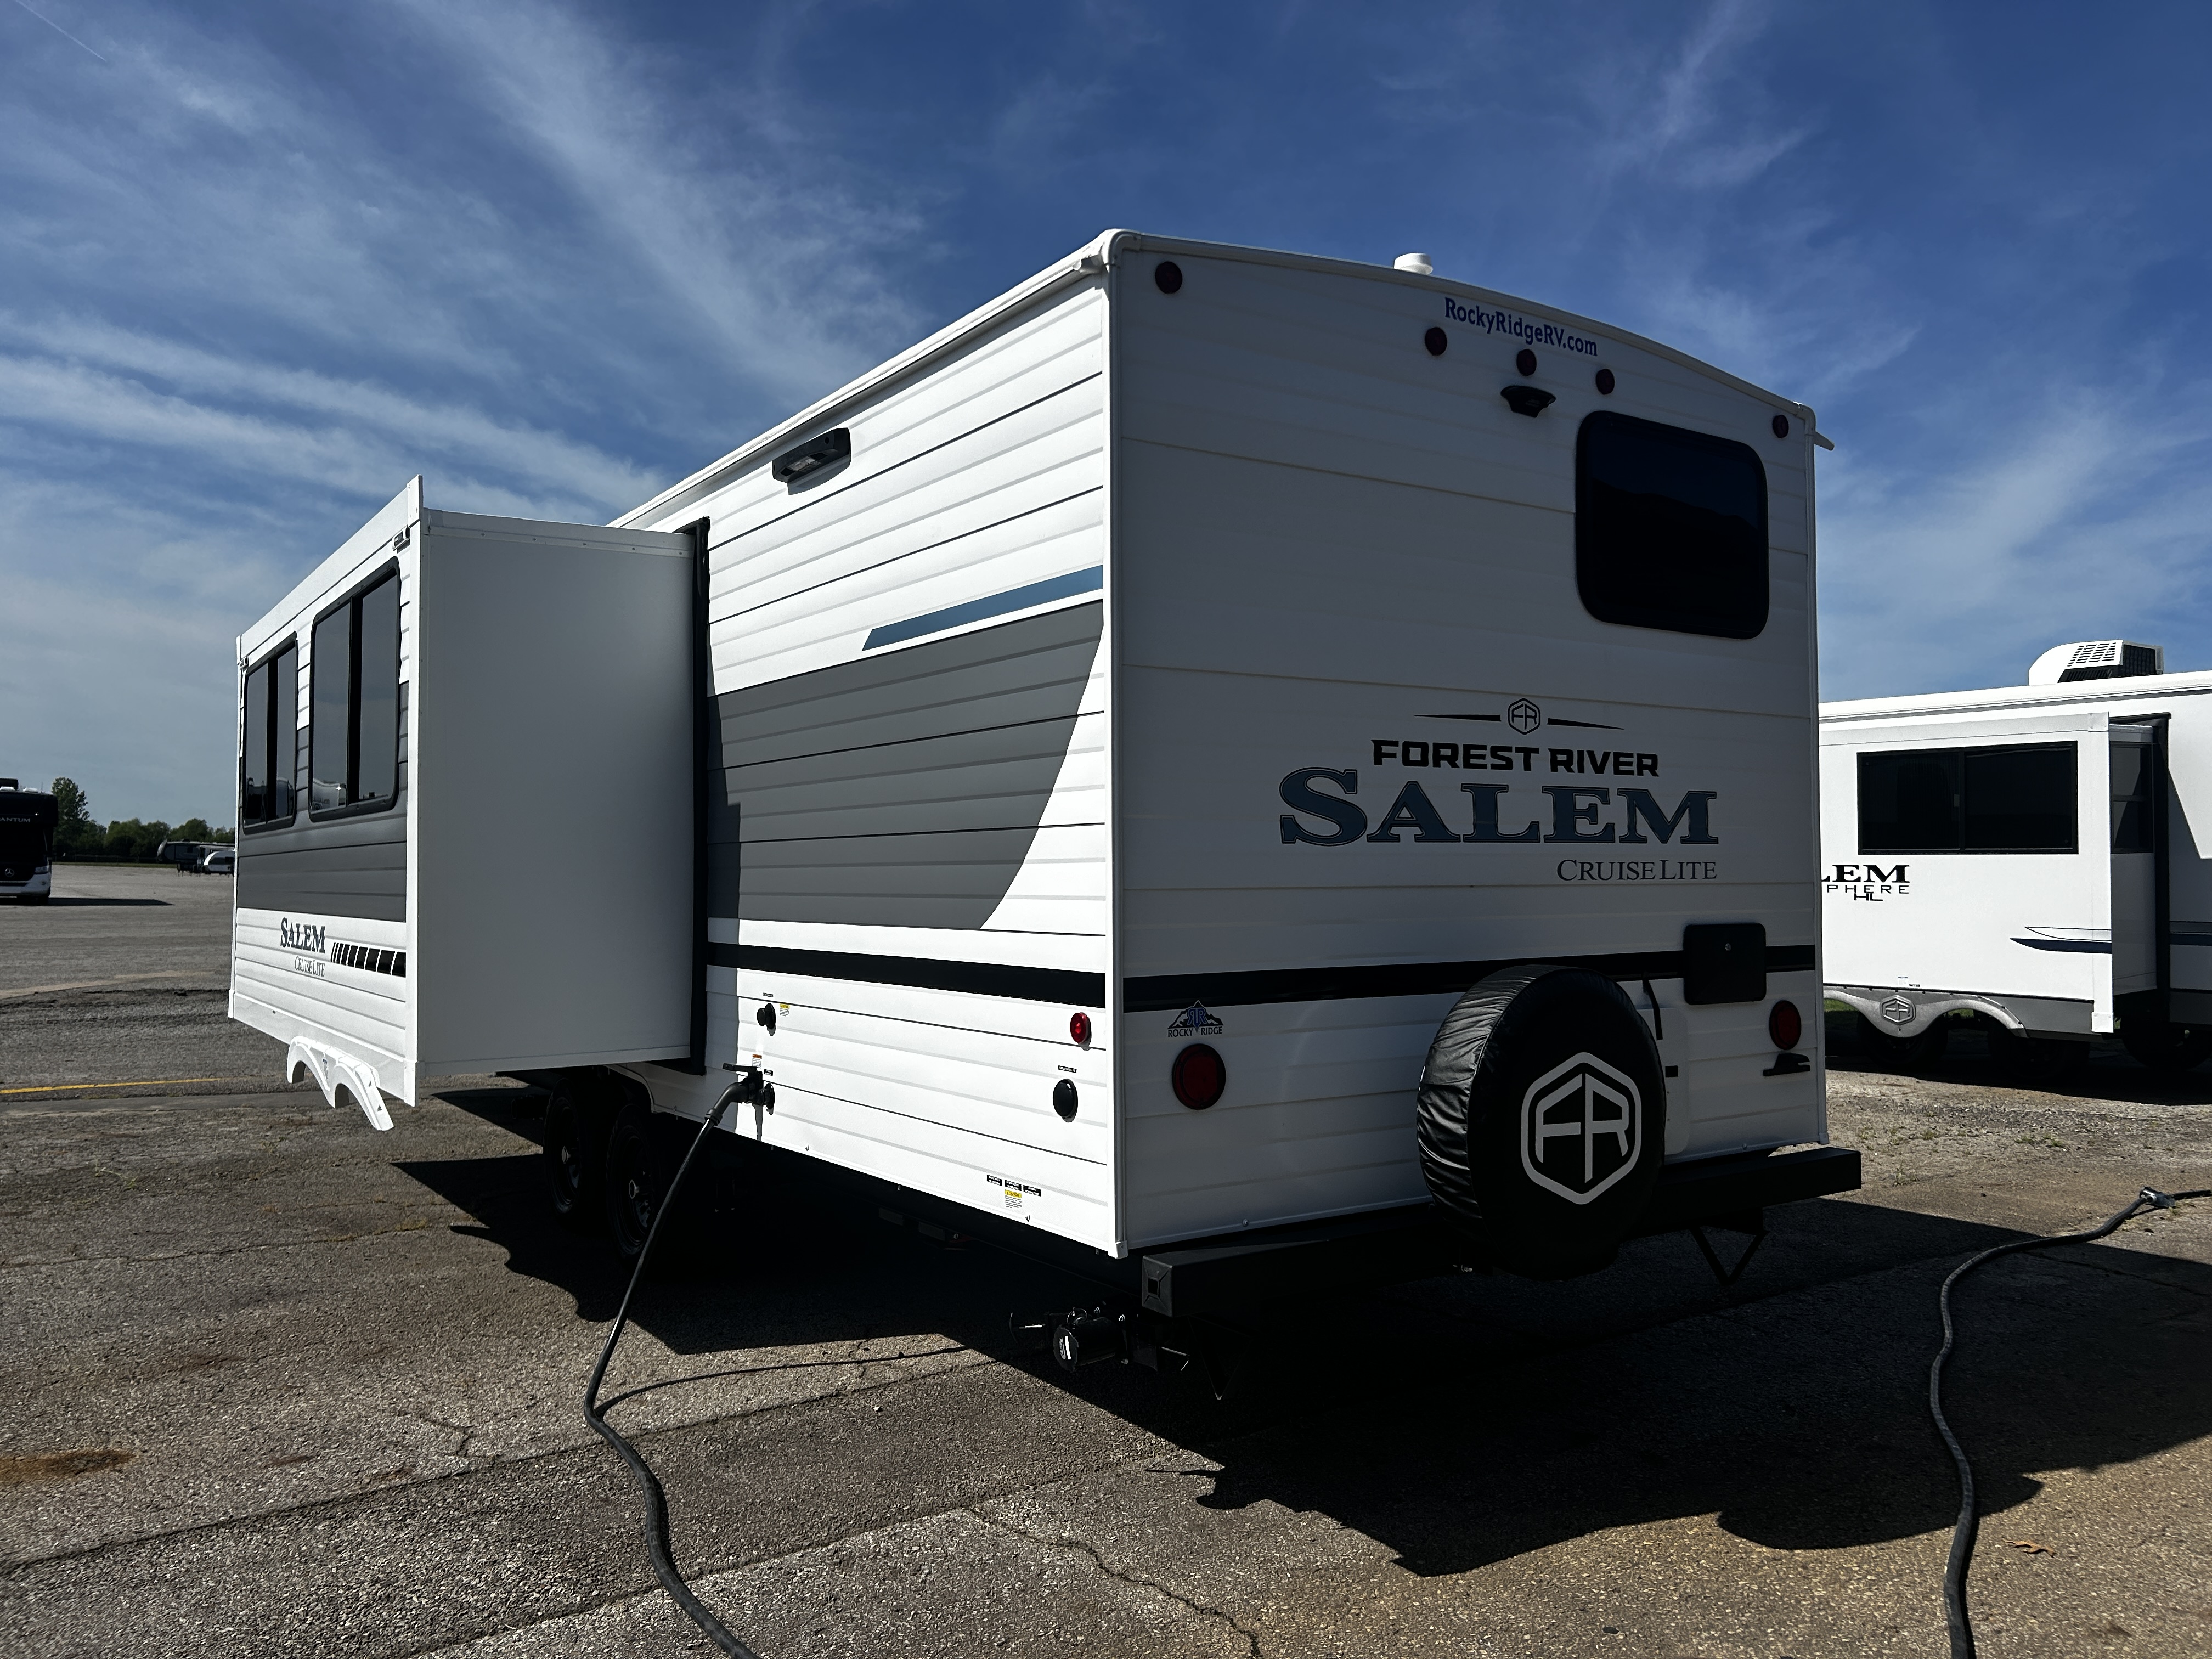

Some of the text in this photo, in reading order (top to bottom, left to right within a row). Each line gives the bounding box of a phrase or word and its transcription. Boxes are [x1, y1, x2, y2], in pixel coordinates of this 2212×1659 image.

[1444, 297, 1598, 356] RockyRidgeRV.com
[1371, 739, 1660, 777] FOREST RIVER
[1279, 767, 1719, 847] SALEM
[1827, 884, 1910, 894] PHERE
[1854, 893, 1883, 901] HL
[280, 917, 326, 953] SALEM
[1167, 1026, 1223, 1037] ROCKY RIDGE
